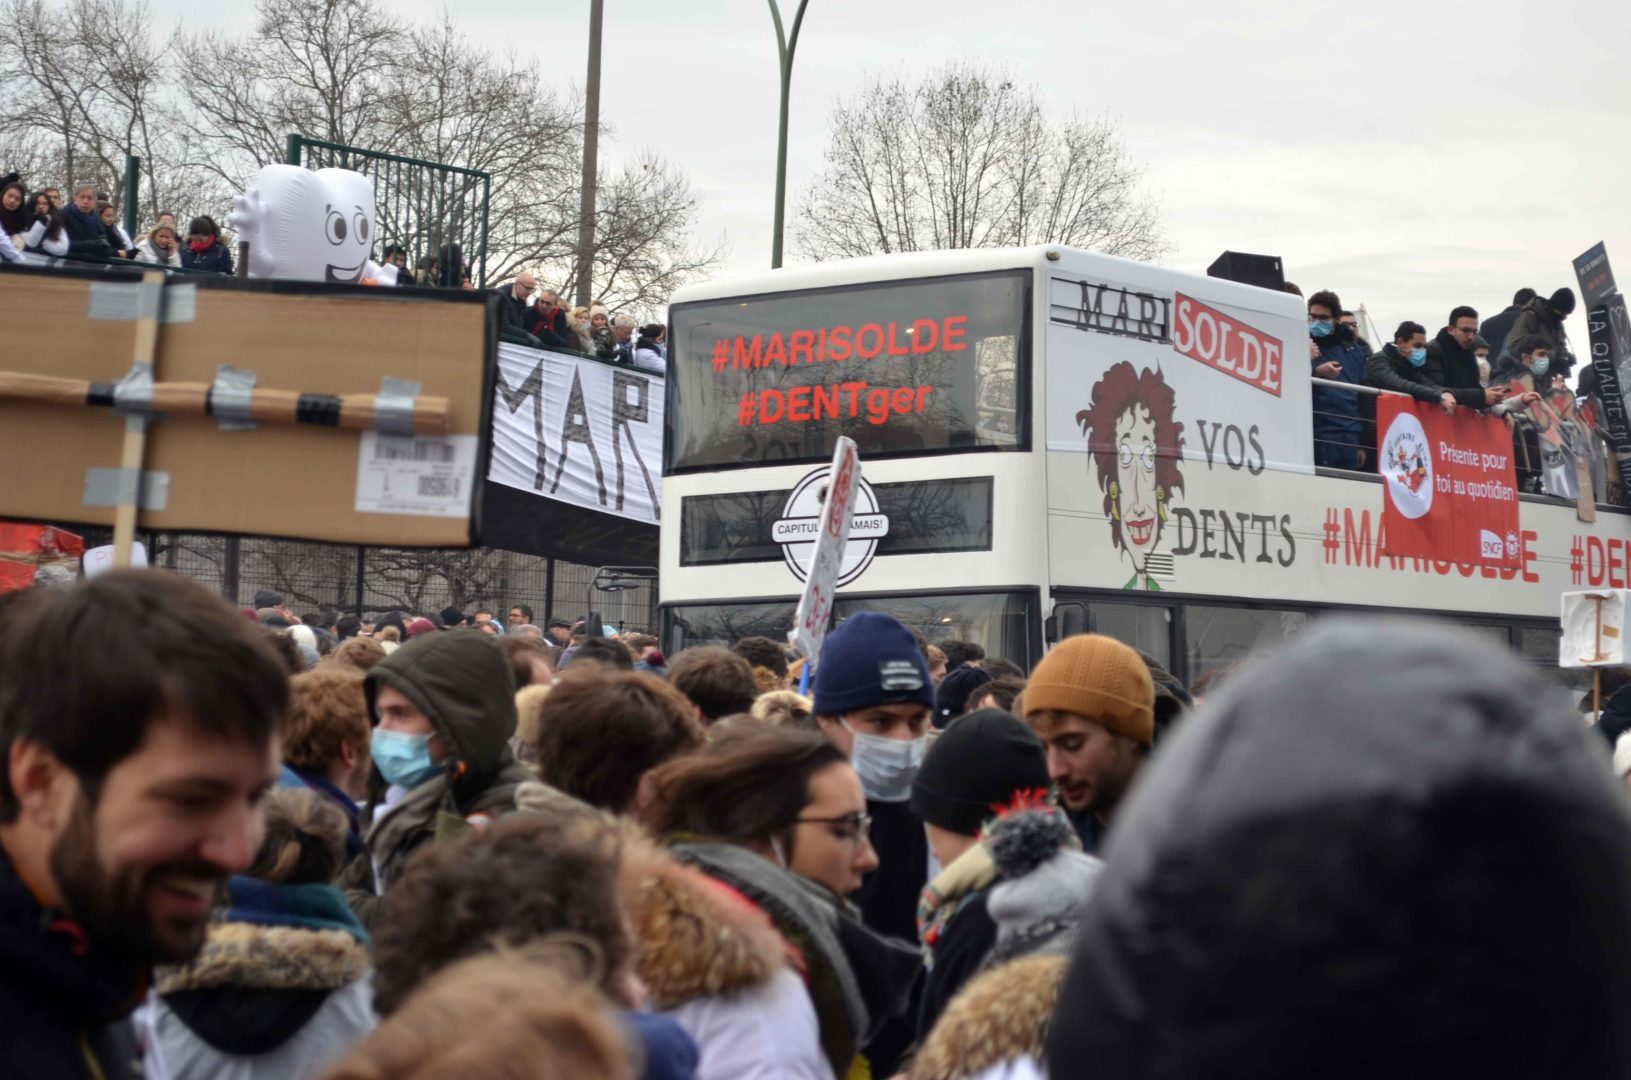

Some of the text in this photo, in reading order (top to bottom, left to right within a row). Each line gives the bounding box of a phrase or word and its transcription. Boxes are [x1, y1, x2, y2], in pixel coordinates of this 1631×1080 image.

[712, 315, 969, 373] #MARISOLDE
[737, 381, 933, 427] #DENTger
[1196, 419, 1265, 476] VOS
[1439, 441, 1507, 472] Présente pour
[1436, 474, 1514, 501] toi au quotidien
[777, 519, 883, 535] CAPITUL AMAIS!
[1172, 507, 1296, 568] DENTS
[1482, 541, 1502, 555] SNCF
